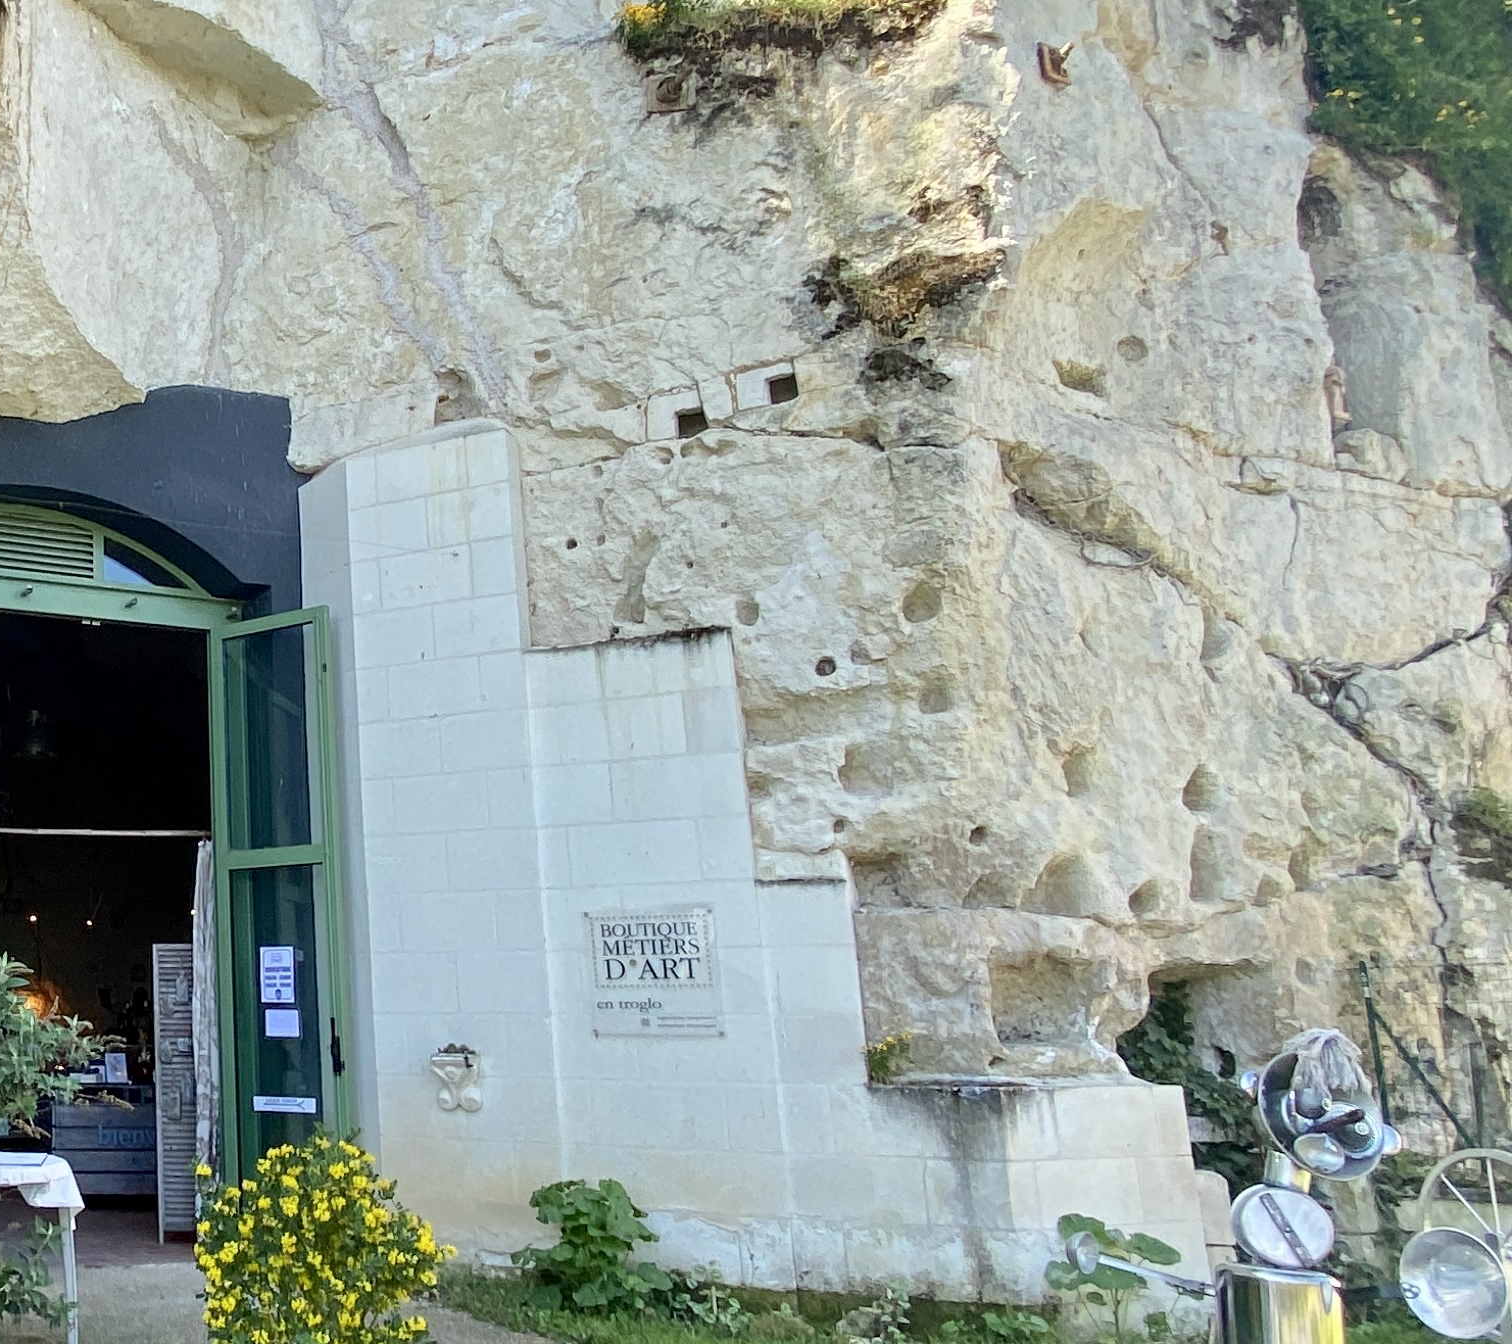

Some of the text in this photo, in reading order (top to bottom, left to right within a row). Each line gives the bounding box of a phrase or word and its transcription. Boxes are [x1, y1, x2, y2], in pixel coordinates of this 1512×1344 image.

[600, 922, 698, 938] BOUTIQUE
[602, 936, 700, 956] MÉTIERS
[596, 998, 662, 1012] en troglo
